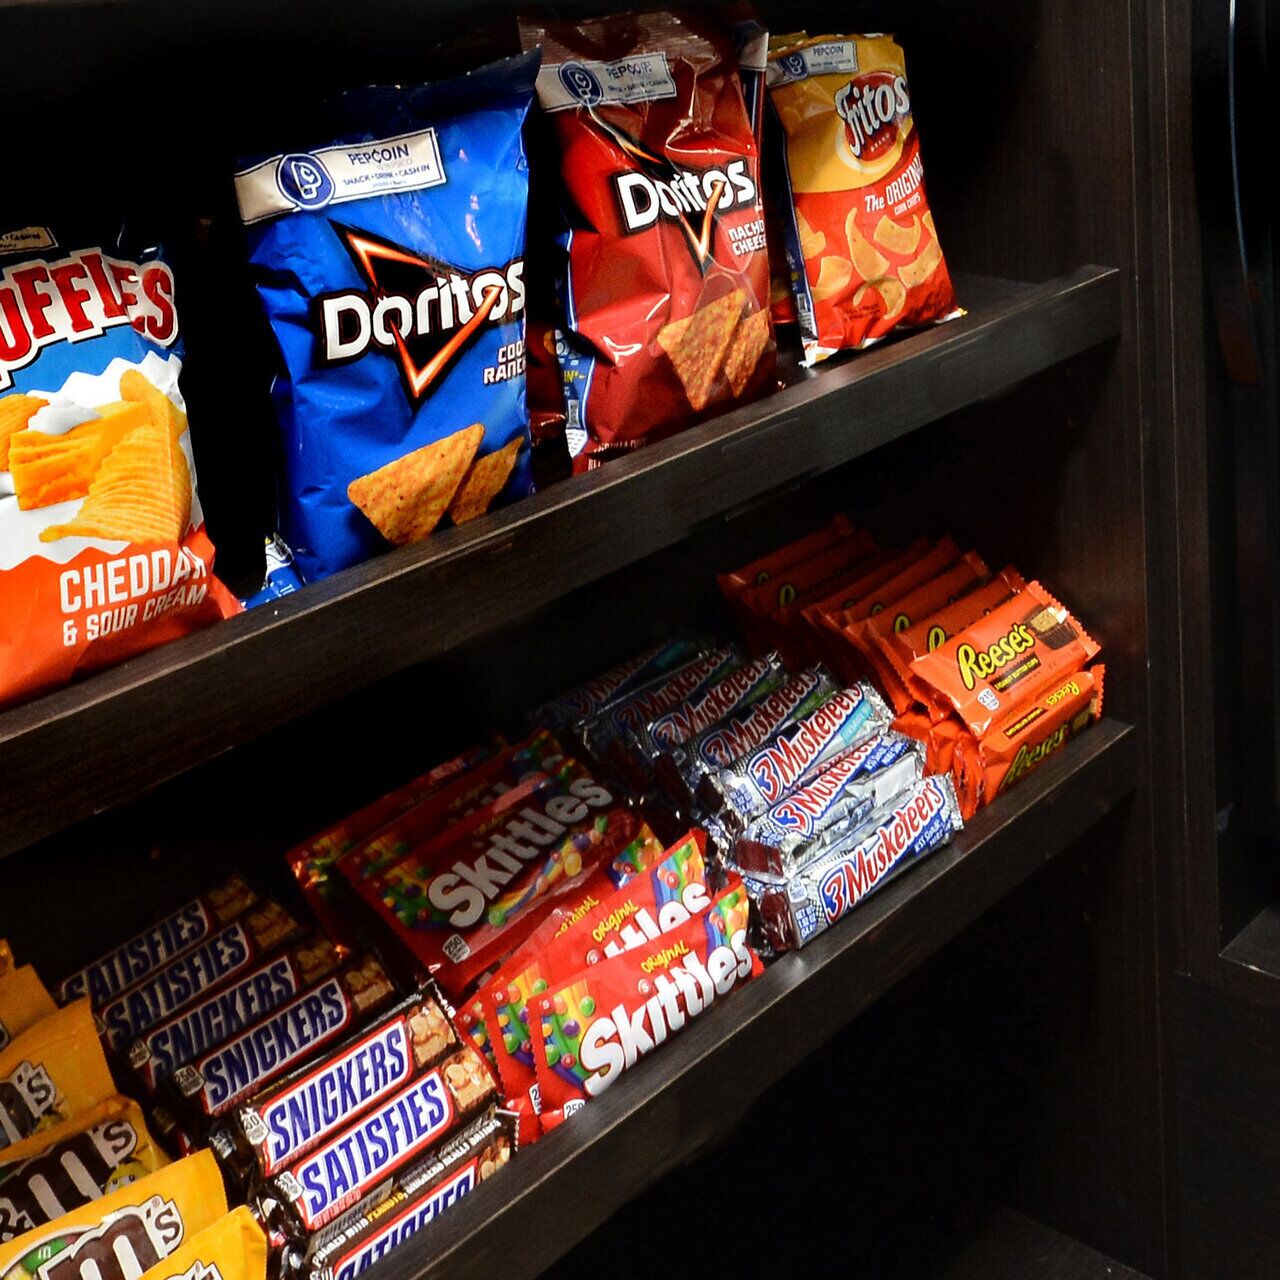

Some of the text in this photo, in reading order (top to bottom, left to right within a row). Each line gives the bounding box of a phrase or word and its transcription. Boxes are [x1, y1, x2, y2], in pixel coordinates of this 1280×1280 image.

[347, 144, 409, 166] PEPCOIN
[836, 76, 910, 156] Fritos
[343, 175, 370, 186] SNACK
[618, 160, 755, 230] Doritos
[865, 190, 885, 212] The
[323, 261, 525, 360] Doritos
[59, 546, 207, 614] CHEDDAR
[62, 583, 208, 647] & SOUR CREAM
[957, 622, 1035, 691] Reese's
[727, 669, 818, 758] Musketeers
[755, 684, 864, 804] 3 Musketeers
[428, 777, 613, 928] Skittles
[777, 807, 809, 834] 3
[823, 782, 943, 919] 3 Musketeers
[591, 898, 639, 941] ORIGINAL
[640, 940, 689, 974] ORIGINAL
[145, 958, 297, 1076] SNICKERS
[200, 979, 347, 1110] SNICKERS
[580, 928, 752, 1098] Skittles
[263, 1020, 407, 1165] SNICKERS
[296, 1078, 447, 1218] SATISFIES
